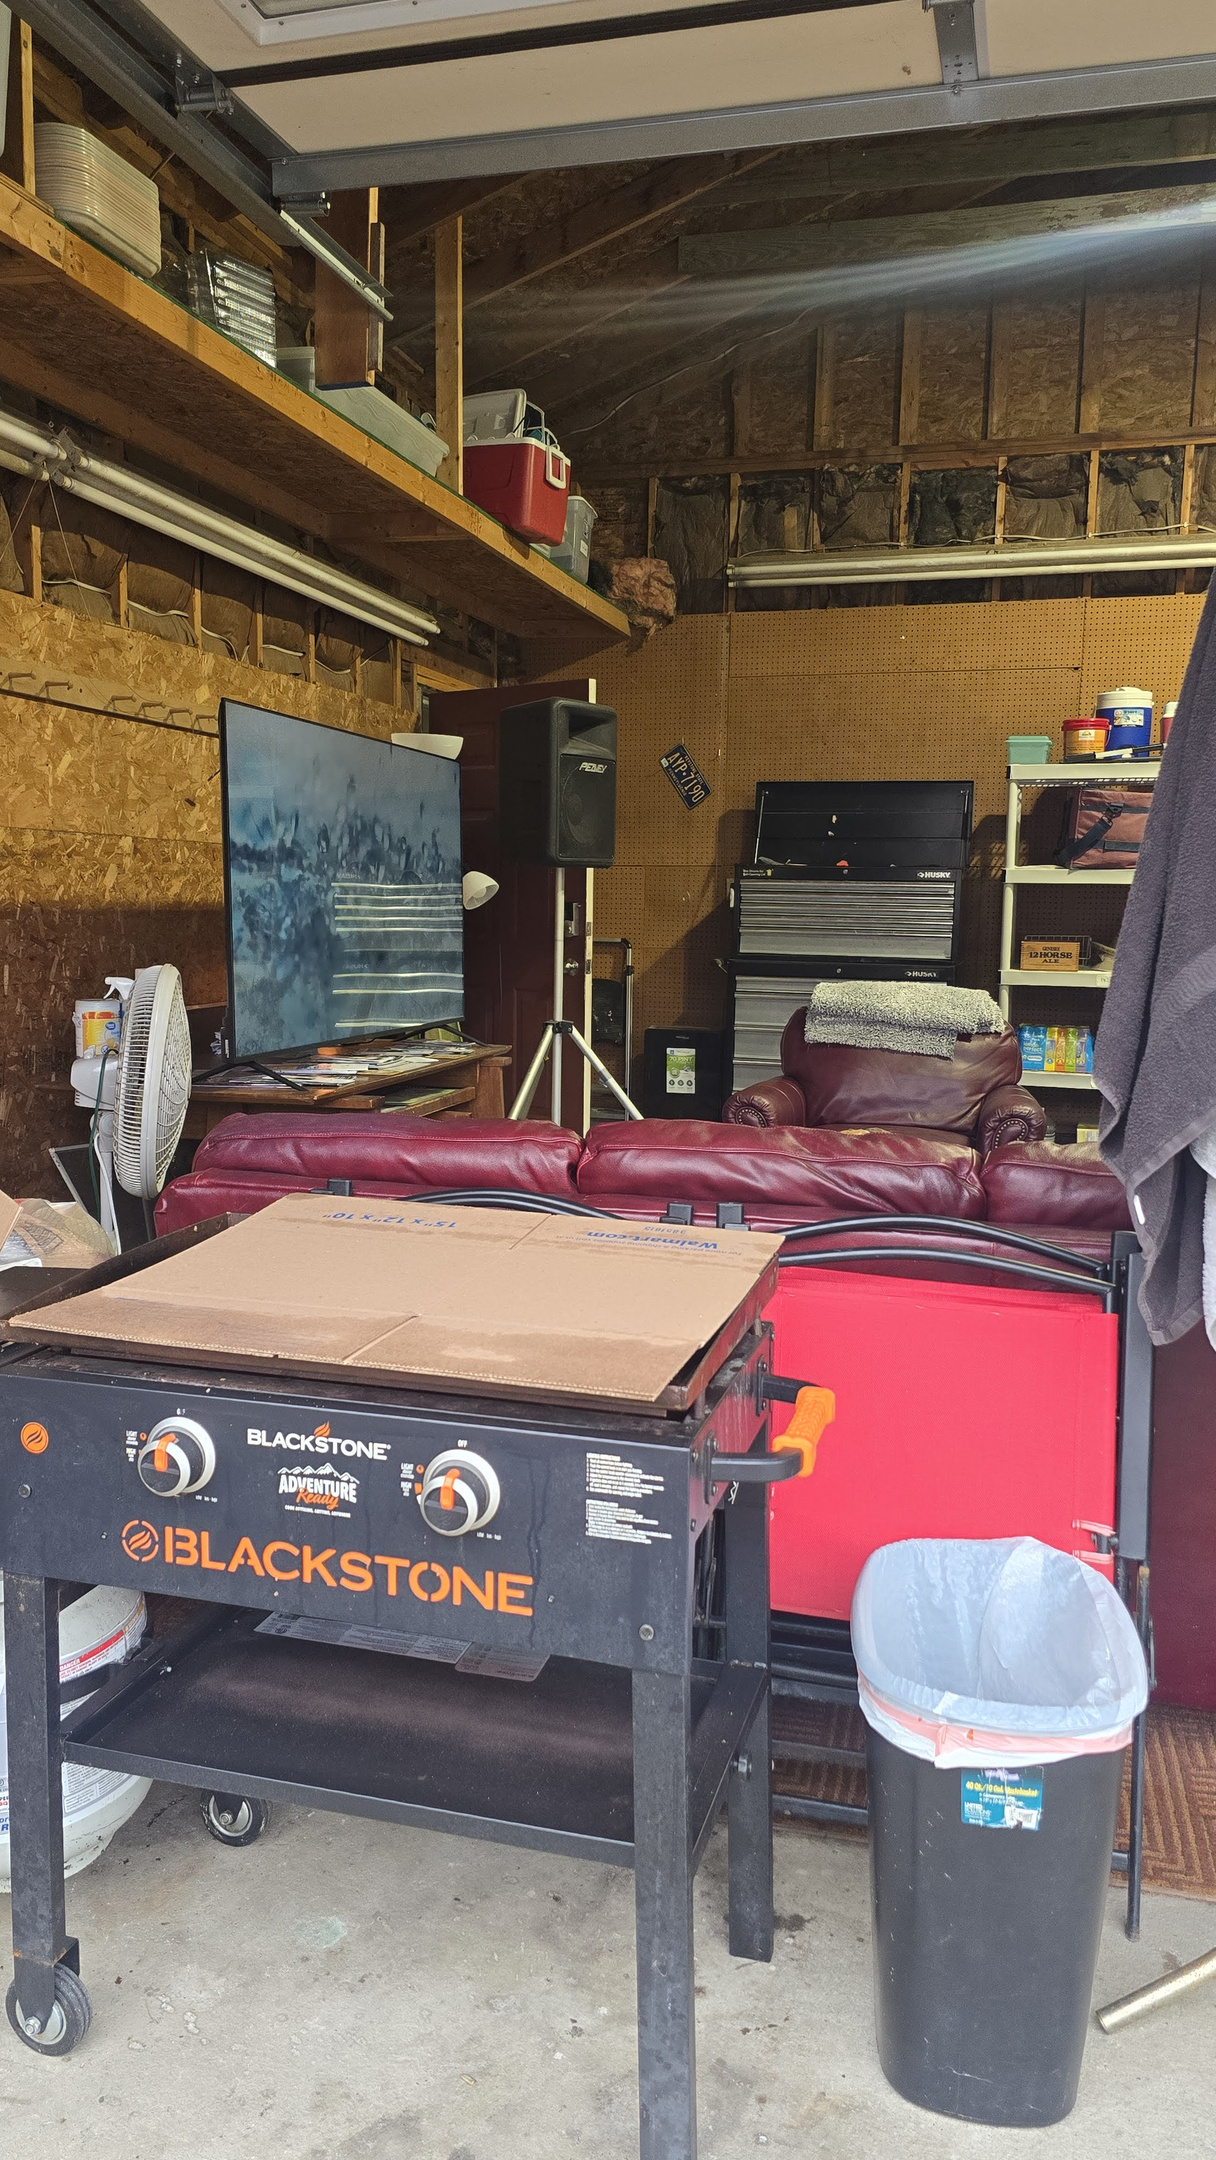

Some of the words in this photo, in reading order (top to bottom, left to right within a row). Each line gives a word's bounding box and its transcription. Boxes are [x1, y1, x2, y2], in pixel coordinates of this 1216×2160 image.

[587, 1231, 718, 1249] Walmart.com
[247, 1428, 388, 1460] BLACKSTONE
[457, 1439, 468, 1448] OFF
[279, 1474, 357, 1504] ADVENTURE
[296, 1487, 339, 1510] Ready
[164, 1526, 533, 1616] BLACKSTONE
[59, 1658, 81, 1672] DANGER
[966, 1781, 974, 1789] 40
